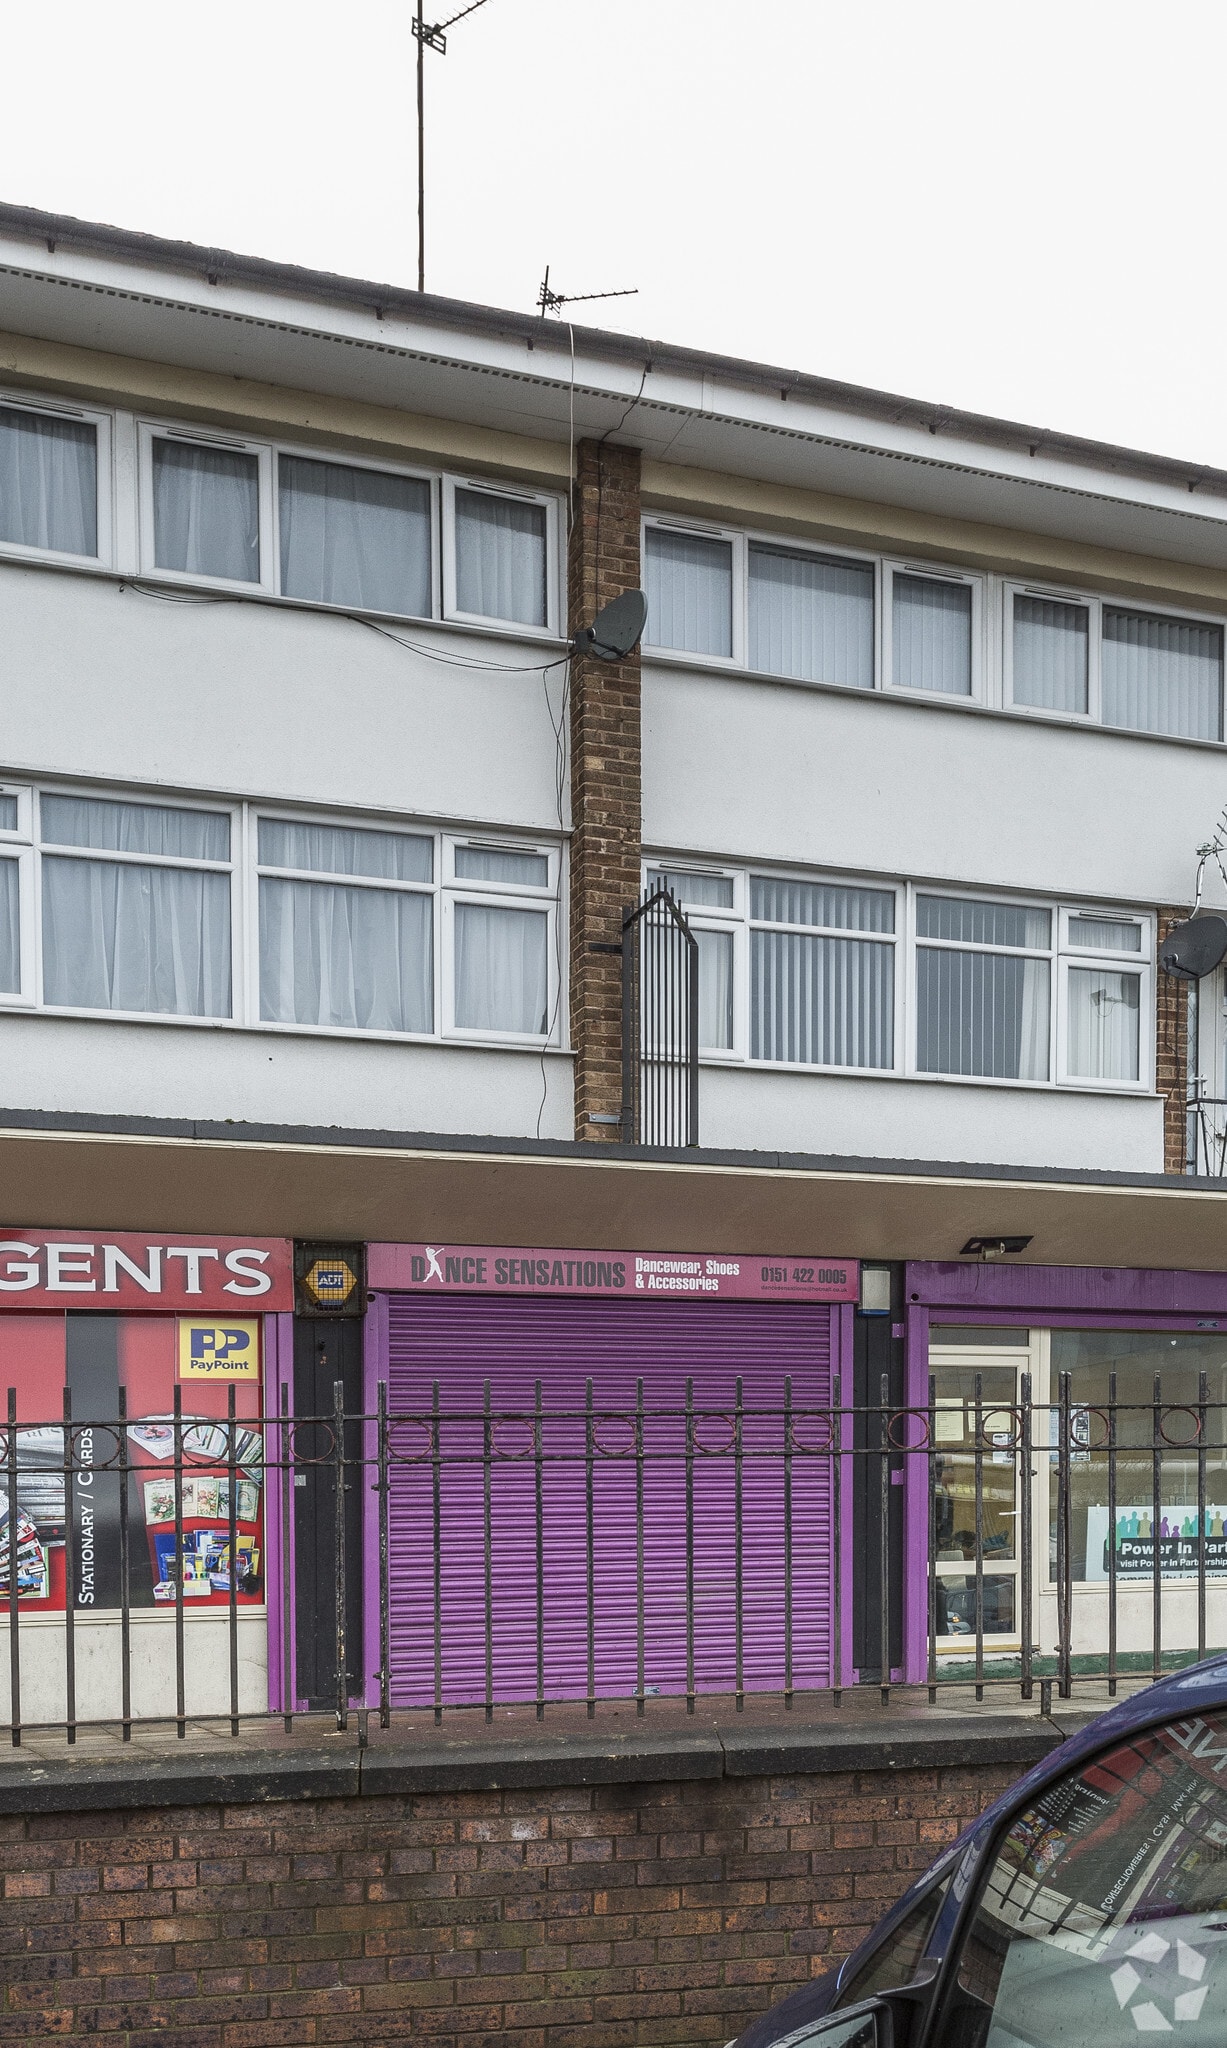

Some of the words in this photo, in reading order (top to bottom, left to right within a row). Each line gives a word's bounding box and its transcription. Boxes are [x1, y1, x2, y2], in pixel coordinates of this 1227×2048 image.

[0, 1241, 272, 1296] GENTS
[494, 1259, 626, 1288] SENSATIONS
[635, 1258, 702, 1276] Dancewear,
[706, 1260, 740, 1275] Shoes
[761, 1267, 787, 1282] 0151
[792, 1268, 814, 1283] 422
[818, 1269, 847, 1284] 0005
[318, 1274, 343, 1285] ADT
[635, 1273, 644, 1289] &
[648, 1274, 719, 1291] Accessories
[190, 1360, 249, 1371] PayPoint
[78, 1505, 95, 1604] STATIONARY
[1177, 1541, 1192, 1554] In
[1120, 1559, 1138, 1568] visit
[1140, 1559, 1168, 1568] Poer
[1170, 1559, 1178, 1567] In
